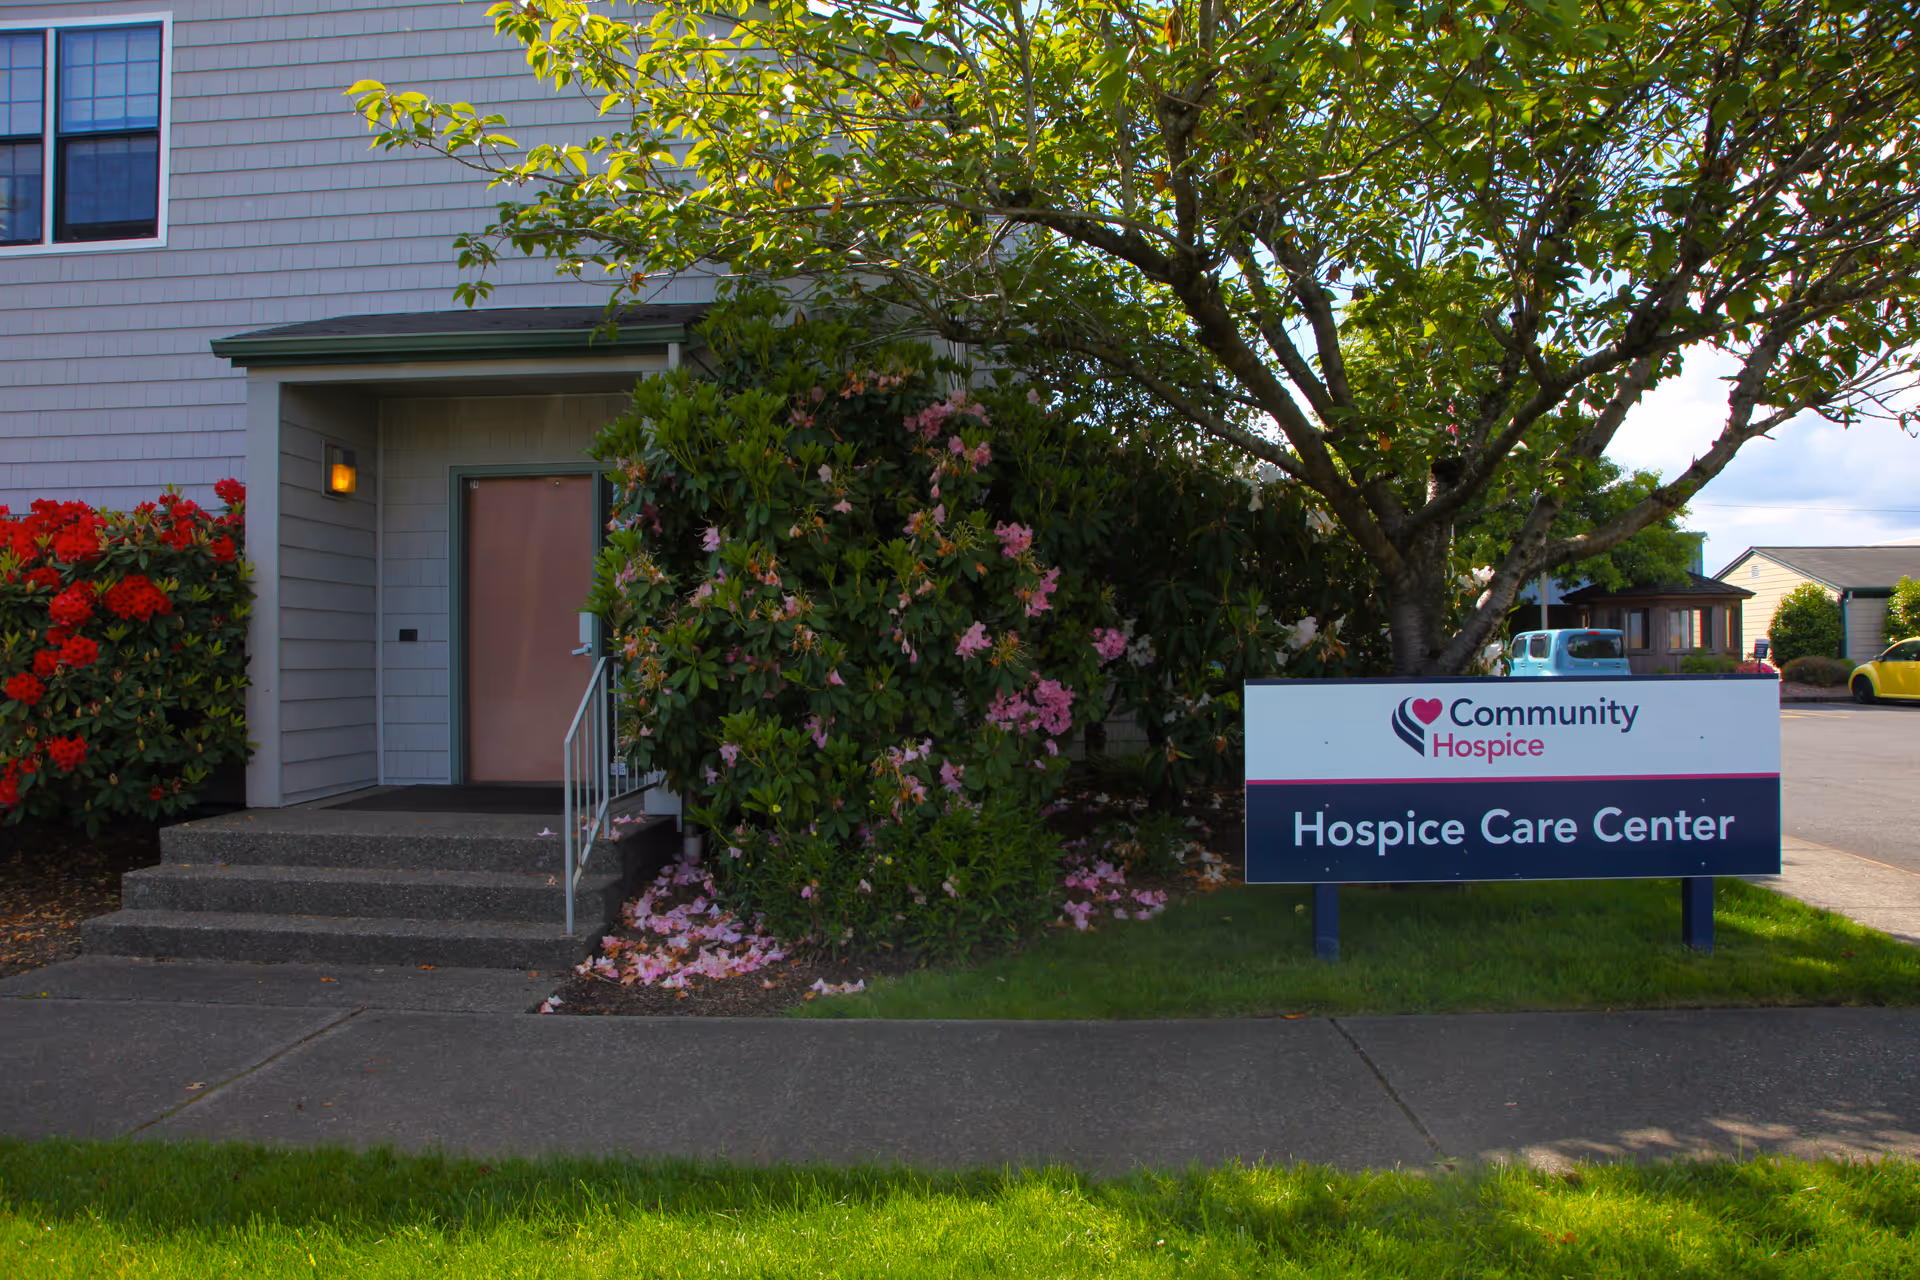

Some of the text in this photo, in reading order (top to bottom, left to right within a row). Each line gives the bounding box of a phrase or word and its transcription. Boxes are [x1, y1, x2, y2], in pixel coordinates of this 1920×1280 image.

[1449, 697, 1639, 733] Community
[1433, 732, 1545, 764] Hospice
[1294, 806, 1736, 856] Hospice Care Center
